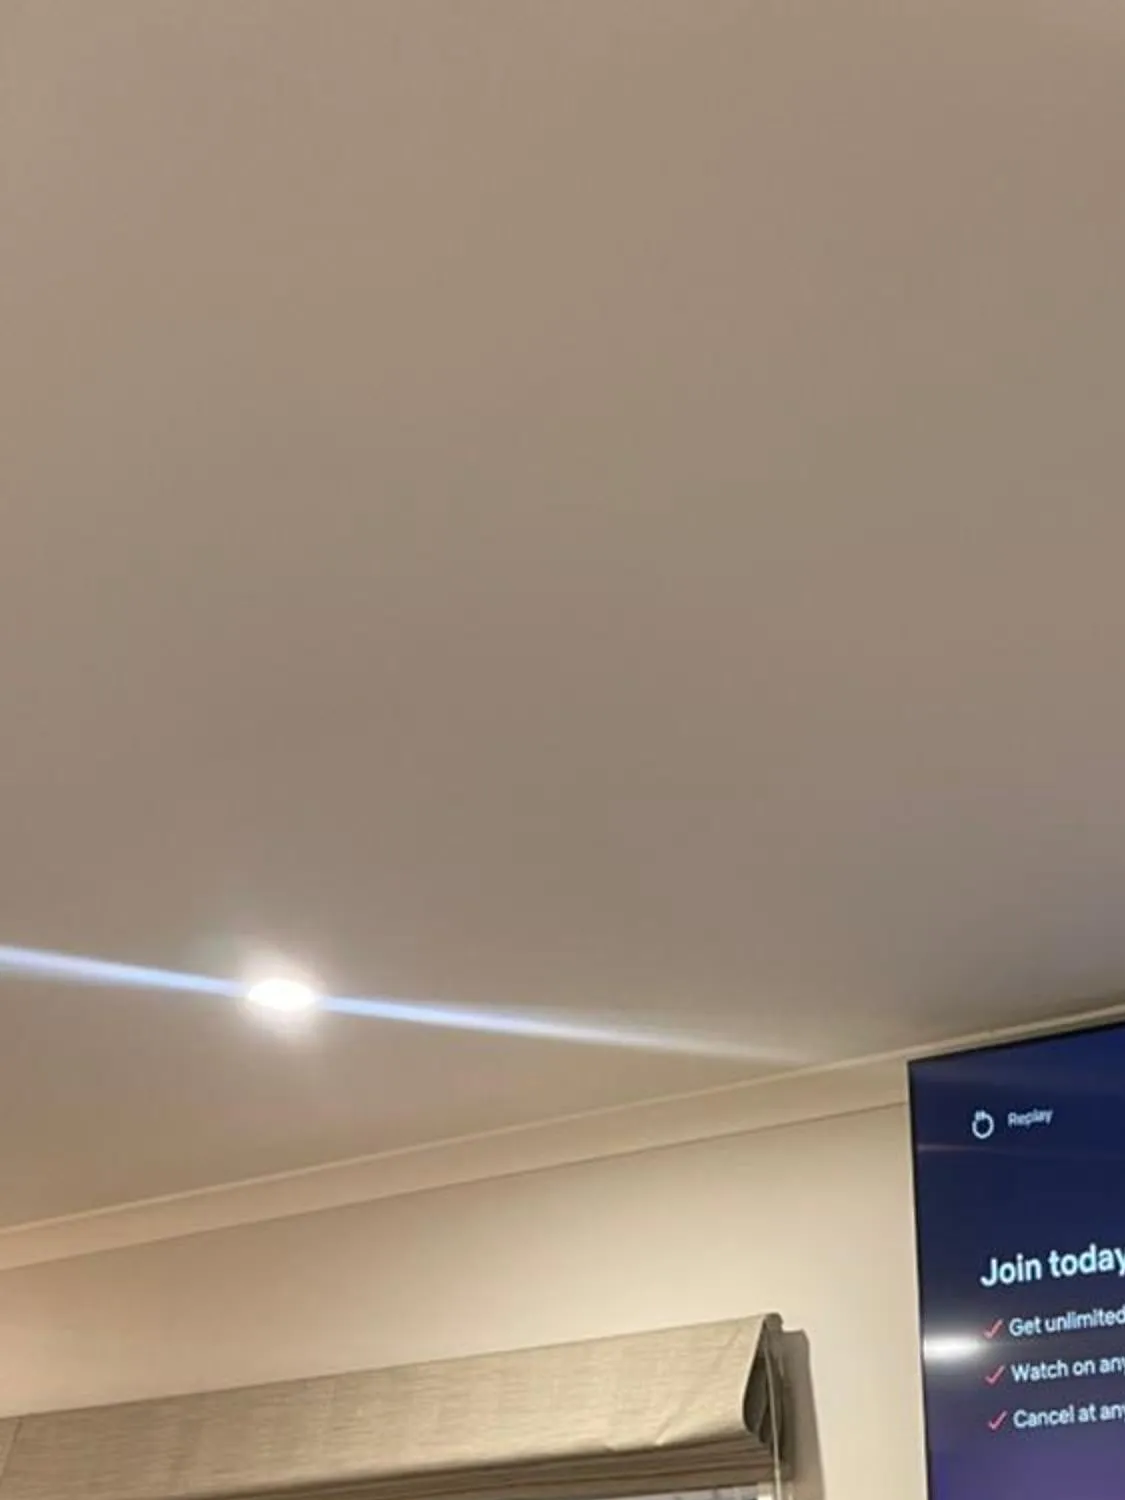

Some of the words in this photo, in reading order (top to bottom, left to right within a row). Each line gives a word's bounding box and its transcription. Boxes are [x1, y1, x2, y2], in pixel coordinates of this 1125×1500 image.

[1007, 1109, 1053, 1127] Replay
[980, 1253, 1042, 1287] Join
[1009, 1317, 1041, 1337] Get
[1011, 1360, 1069, 1383] Watch
[1073, 1358, 1096, 1376] on
[1013, 1405, 1075, 1428] Cancel
[1078, 1405, 1097, 1421] at
